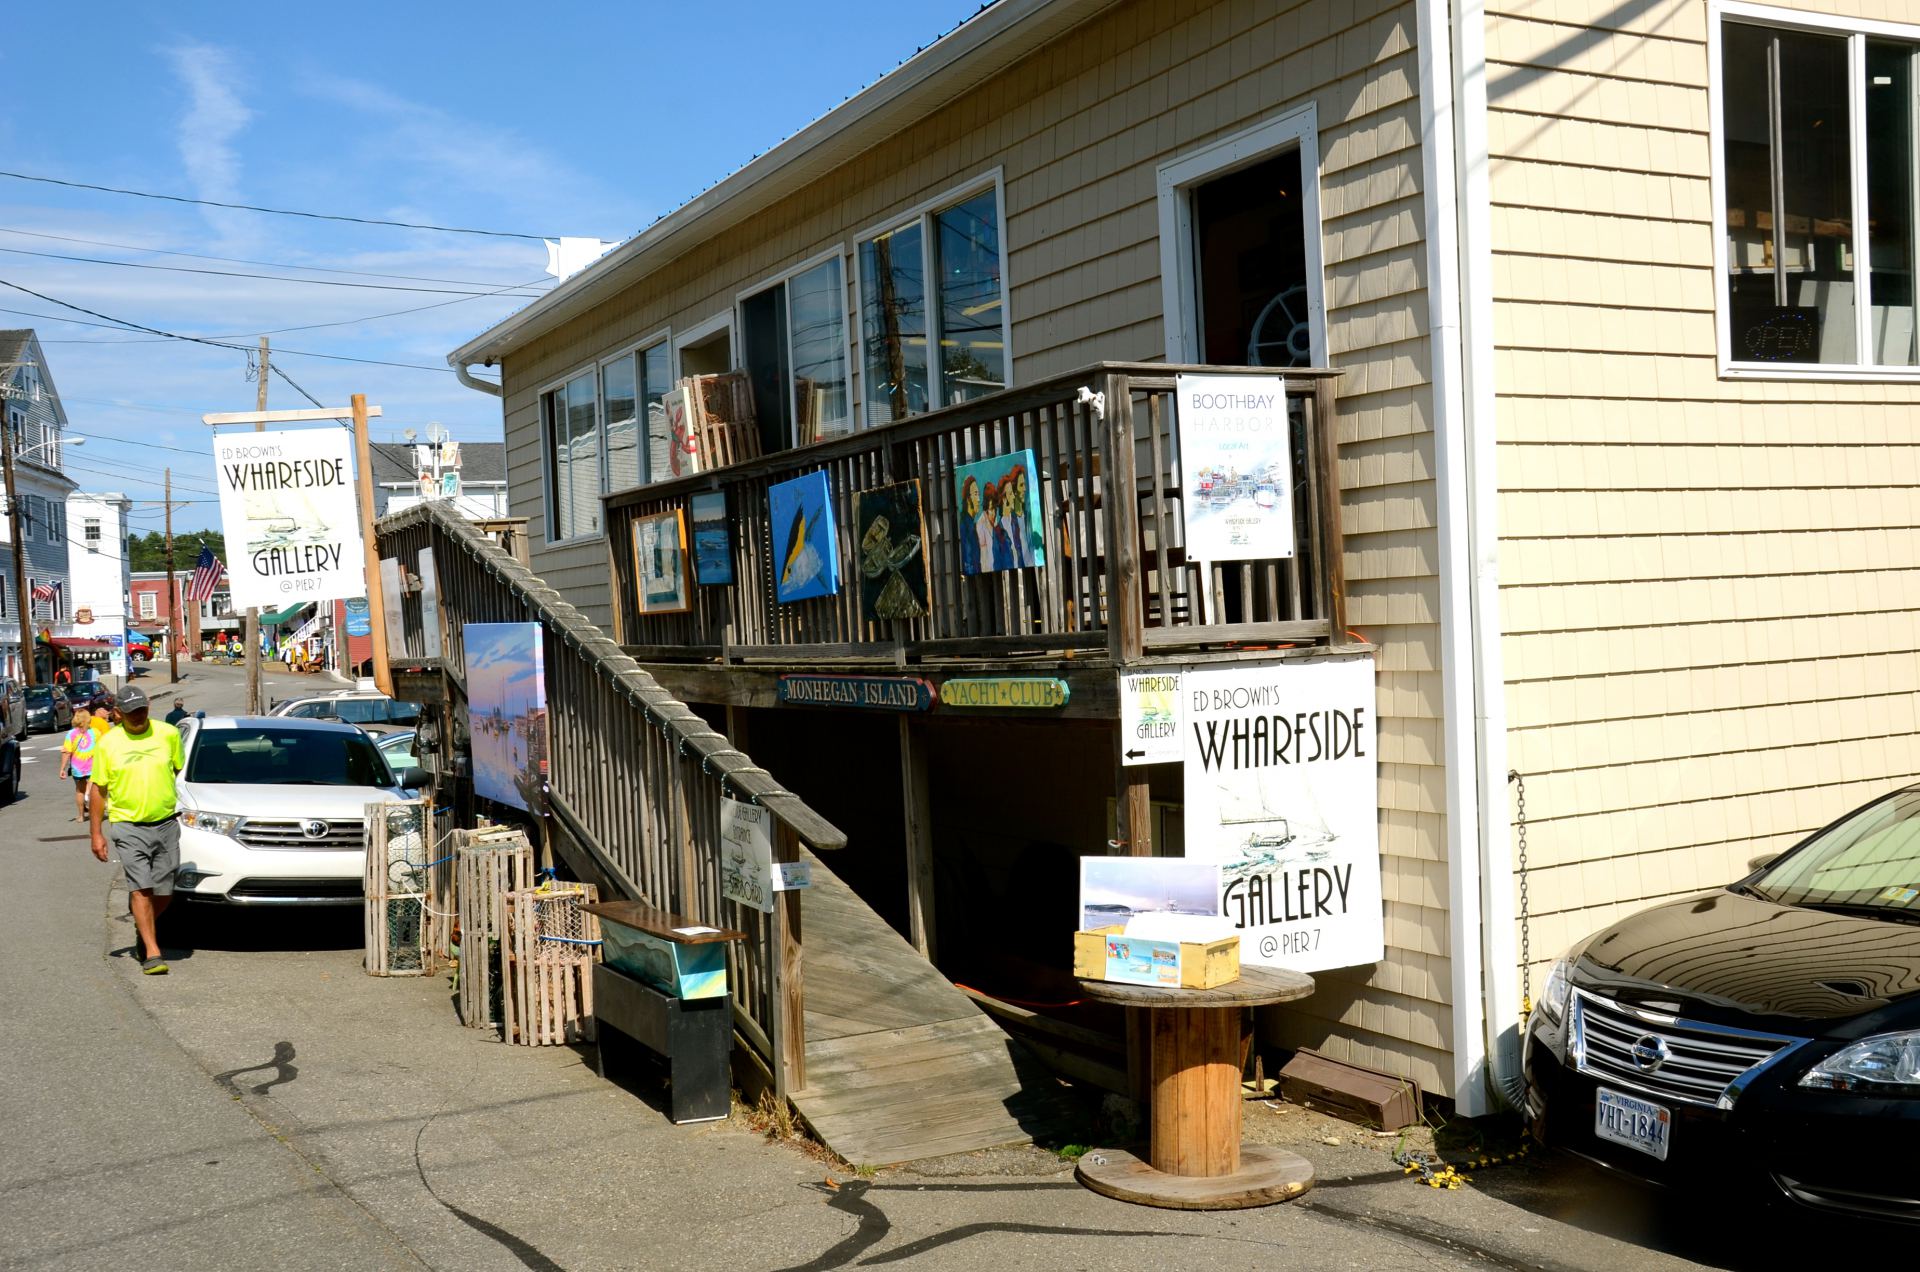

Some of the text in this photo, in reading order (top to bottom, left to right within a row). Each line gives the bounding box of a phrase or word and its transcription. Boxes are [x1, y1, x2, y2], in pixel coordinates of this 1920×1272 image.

[1745, 326, 1813, 350] OPEN
[1192, 393, 1276, 410] BOOTHBAY
[1193, 416, 1274, 432] HARBOR
[222, 445, 283, 460] ED BROWN'S
[223, 458, 346, 493] WHARFSIDE
[253, 543, 342, 577] GALLERY
[280, 577, 323, 593] @ PIER 7
[785, 677, 919, 706] MONHEGAN ISLAND
[949, 681, 1054, 706] YACHT CLUB
[1128, 675, 1180, 693] WHARFSIDE
[1193, 685, 1280, 712] ED BROWN'S
[1136, 722, 1176, 739] GALLERY
[1193, 707, 1366, 774] WHARFSIDE
[1223, 863, 1353, 929] GALLERY
[1259, 929, 1321, 958] @ PIER 7
[1615, 1095, 1654, 1116] VIRGINIA
[1599, 1102, 1665, 1145] VHT-1844
